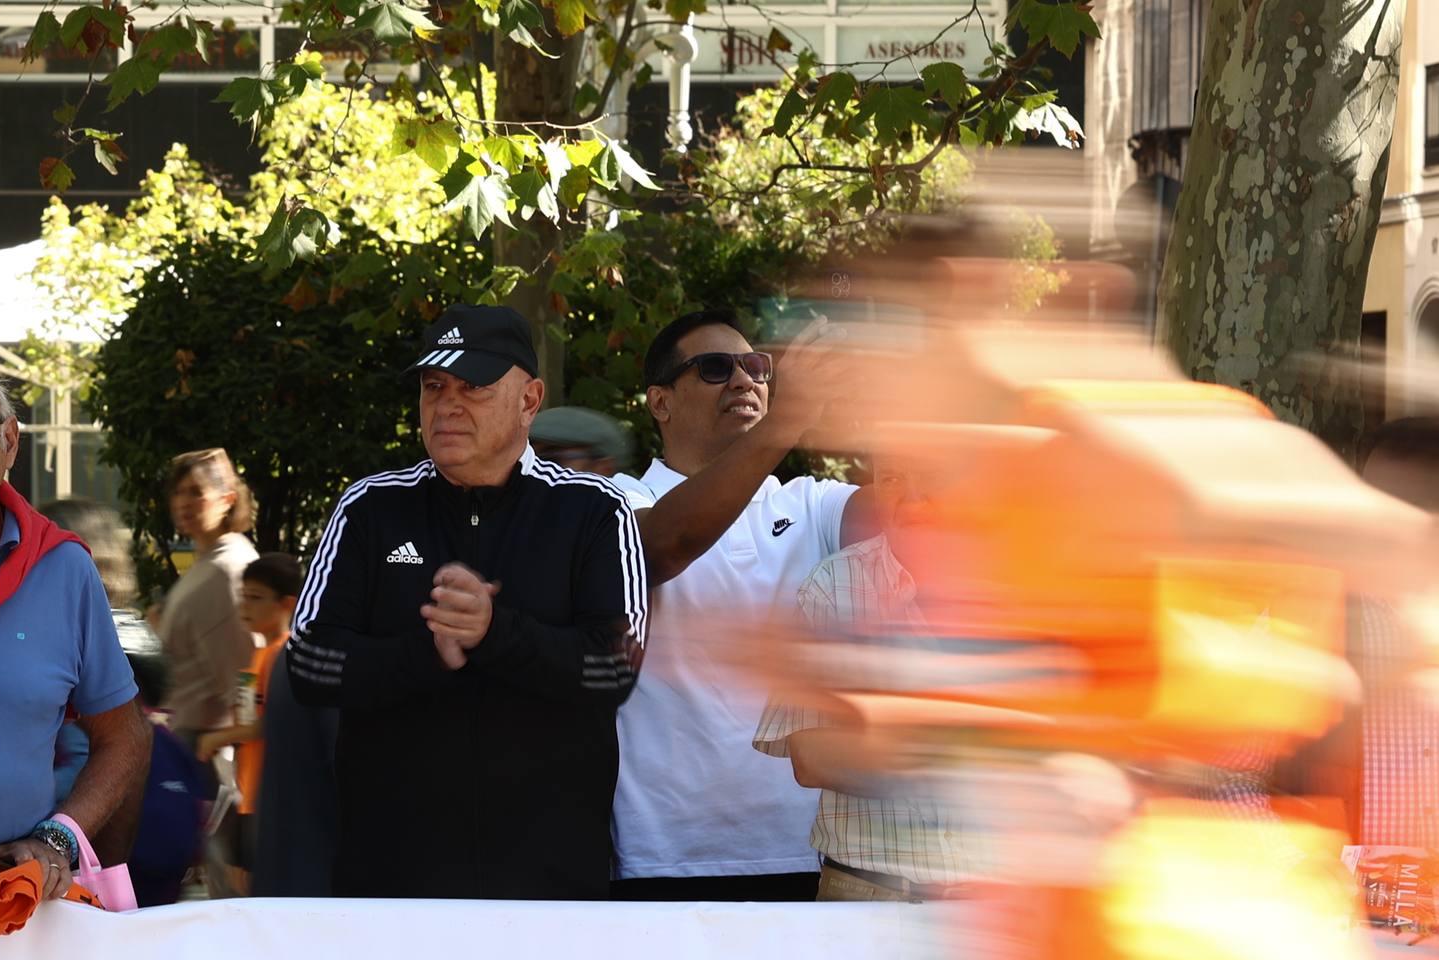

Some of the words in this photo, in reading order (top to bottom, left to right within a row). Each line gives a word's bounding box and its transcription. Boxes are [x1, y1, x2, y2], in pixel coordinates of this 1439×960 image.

[864, 40, 968, 60] ASESORES
[437, 336, 465, 345] adidas
[386, 553, 425, 565] adidas
[1392, 863, 1420, 927] MILLA
